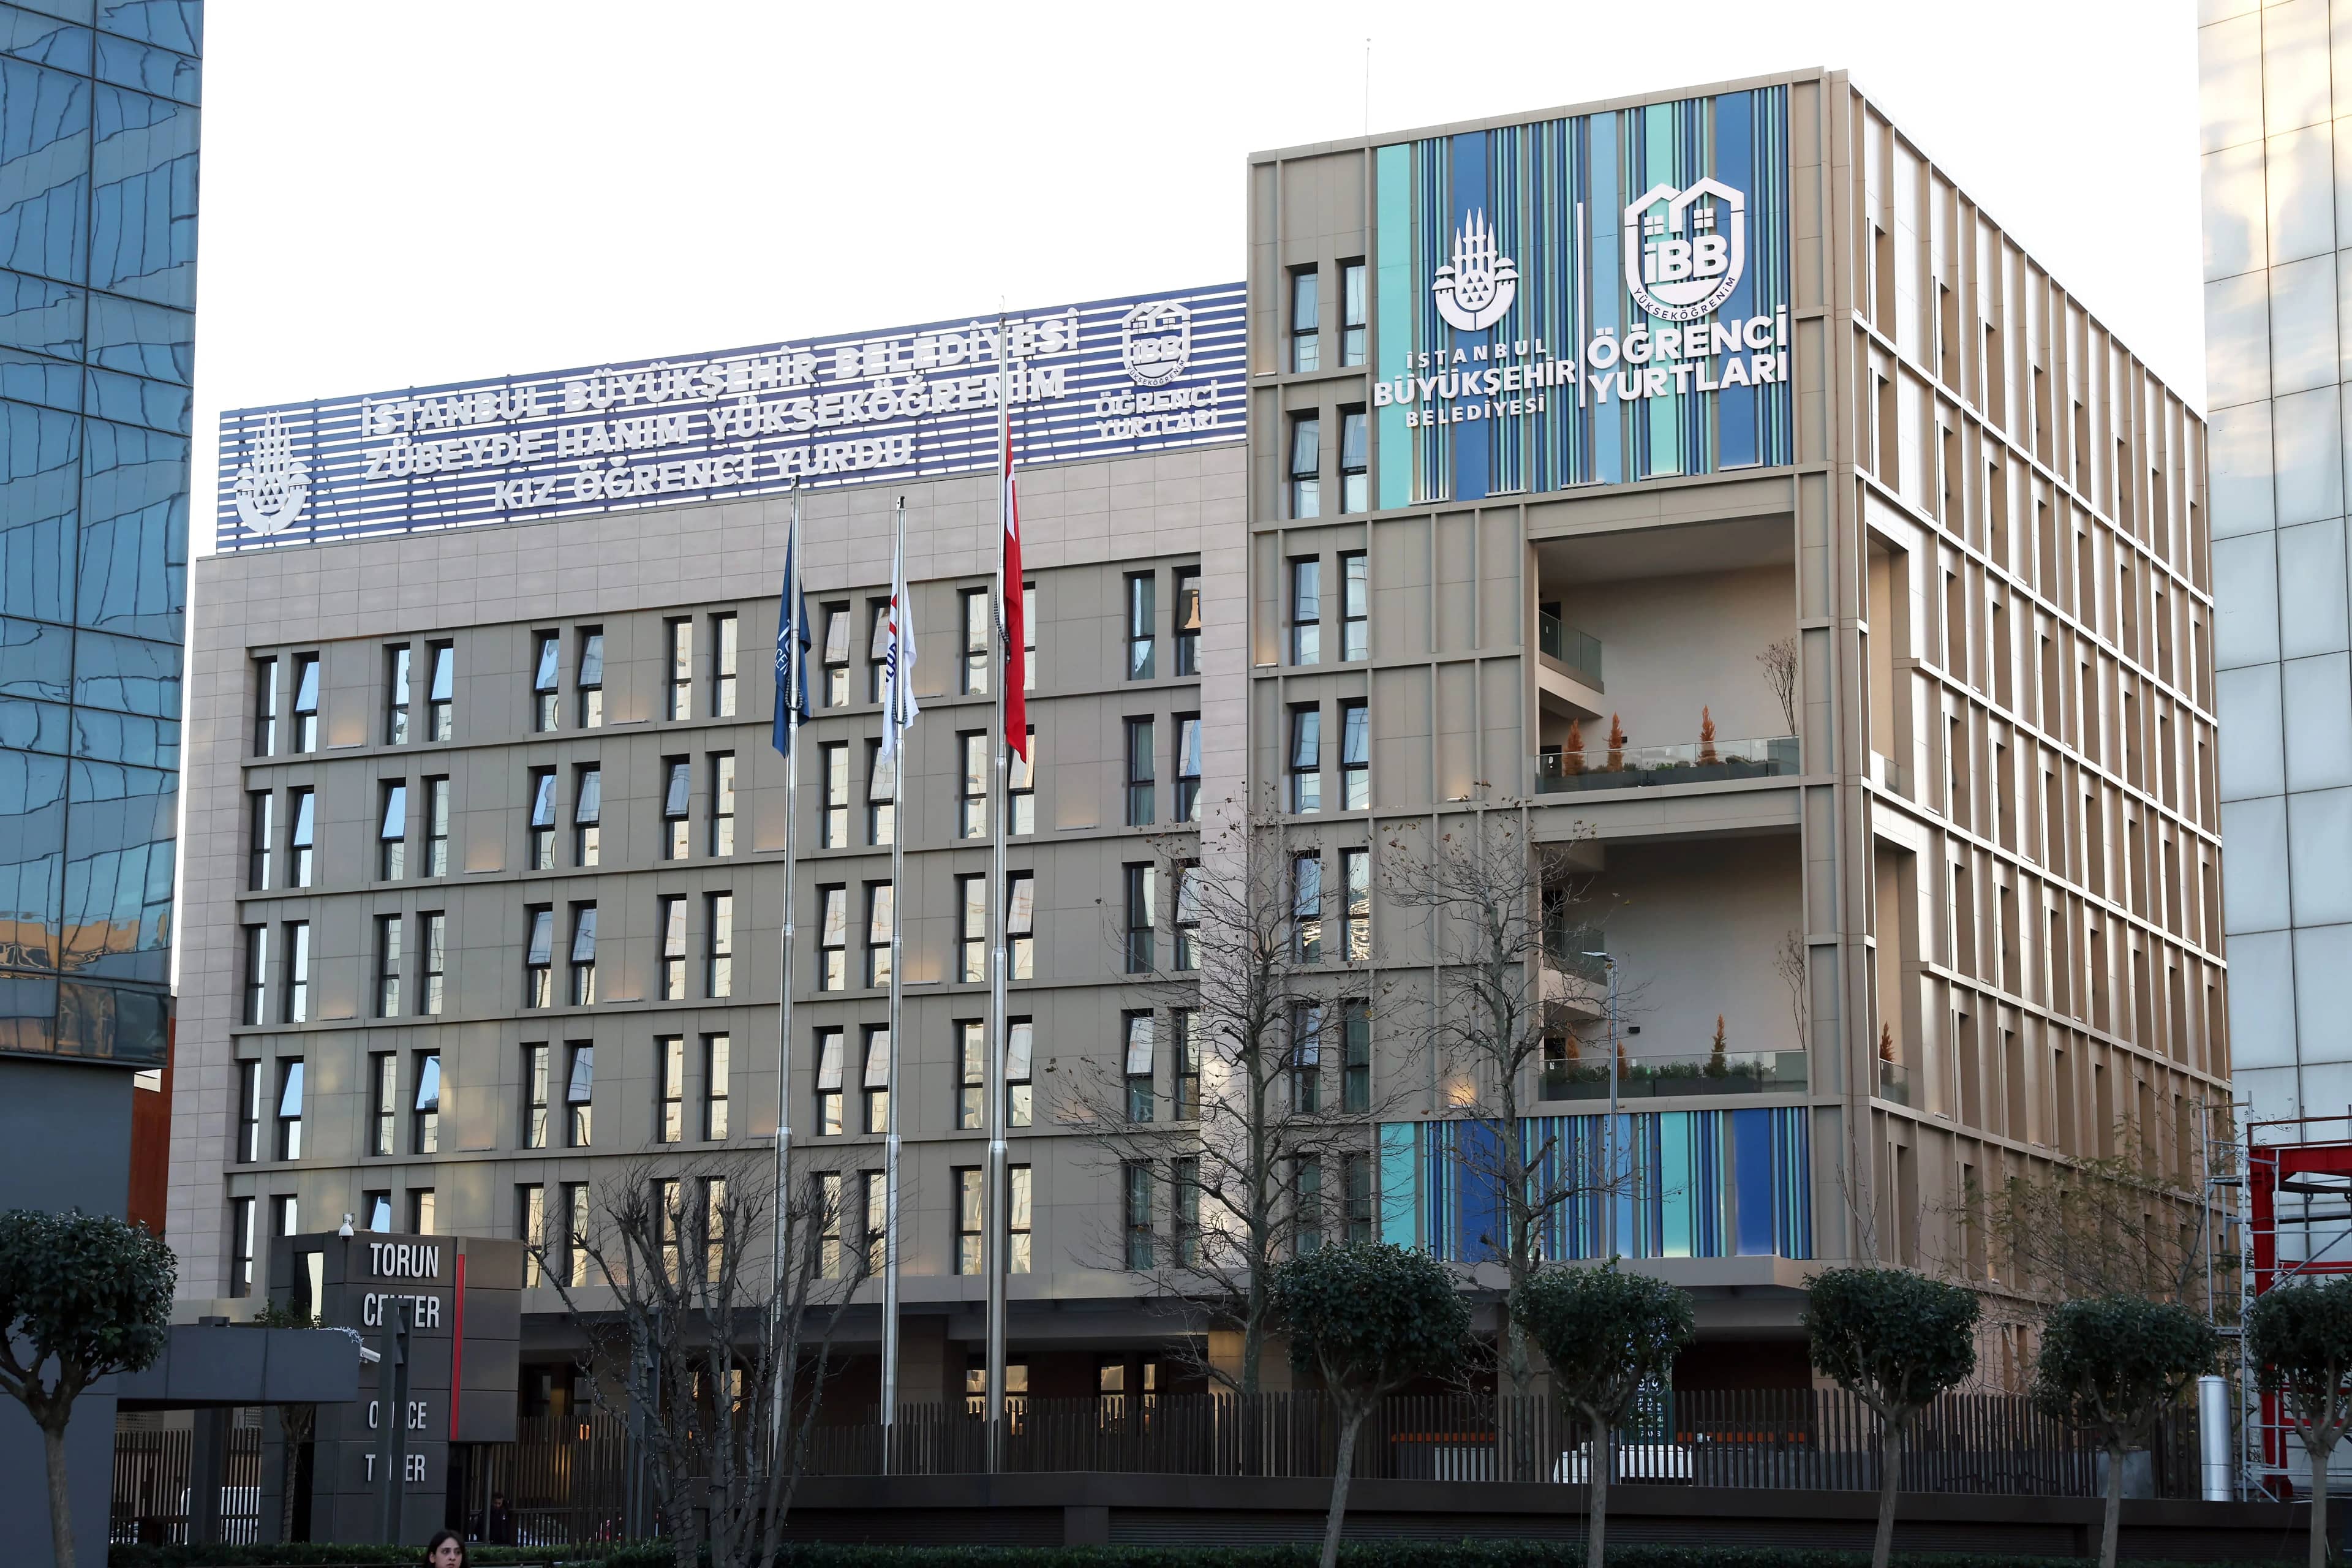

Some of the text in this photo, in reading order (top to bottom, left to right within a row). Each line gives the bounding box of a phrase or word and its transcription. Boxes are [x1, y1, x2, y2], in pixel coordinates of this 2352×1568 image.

[1406, 339, 1547, 369] İSTANBUL
[1587, 304, 1787, 369] ÖĞRENCİ
[362, 307, 1078, 436] İSTANBUL BÜYÜKŞEHİR BELEDİYESİ
[1374, 357, 1577, 407] BÜYÜKŞEHİR
[1588, 352, 1787, 403] YURTLARI
[1095, 380, 1218, 418] ÖĞRENCİ
[1406, 394, 1545, 428] BELEDİYESİ
[366, 361, 1065, 480] ZÜBEYDE HANIM YÜKSEKÖĞRENİM
[1096, 408, 1218, 439] YURTLARI
[495, 434, 911, 510] KIZ ÖĞRENCİ YURDU
[370, 1243, 439, 1278] TORUN
[363, 1293, 440, 1328] CEER
[369, 1401, 427, 1429] OCE
[365, 1454, 425, 1482] TER
